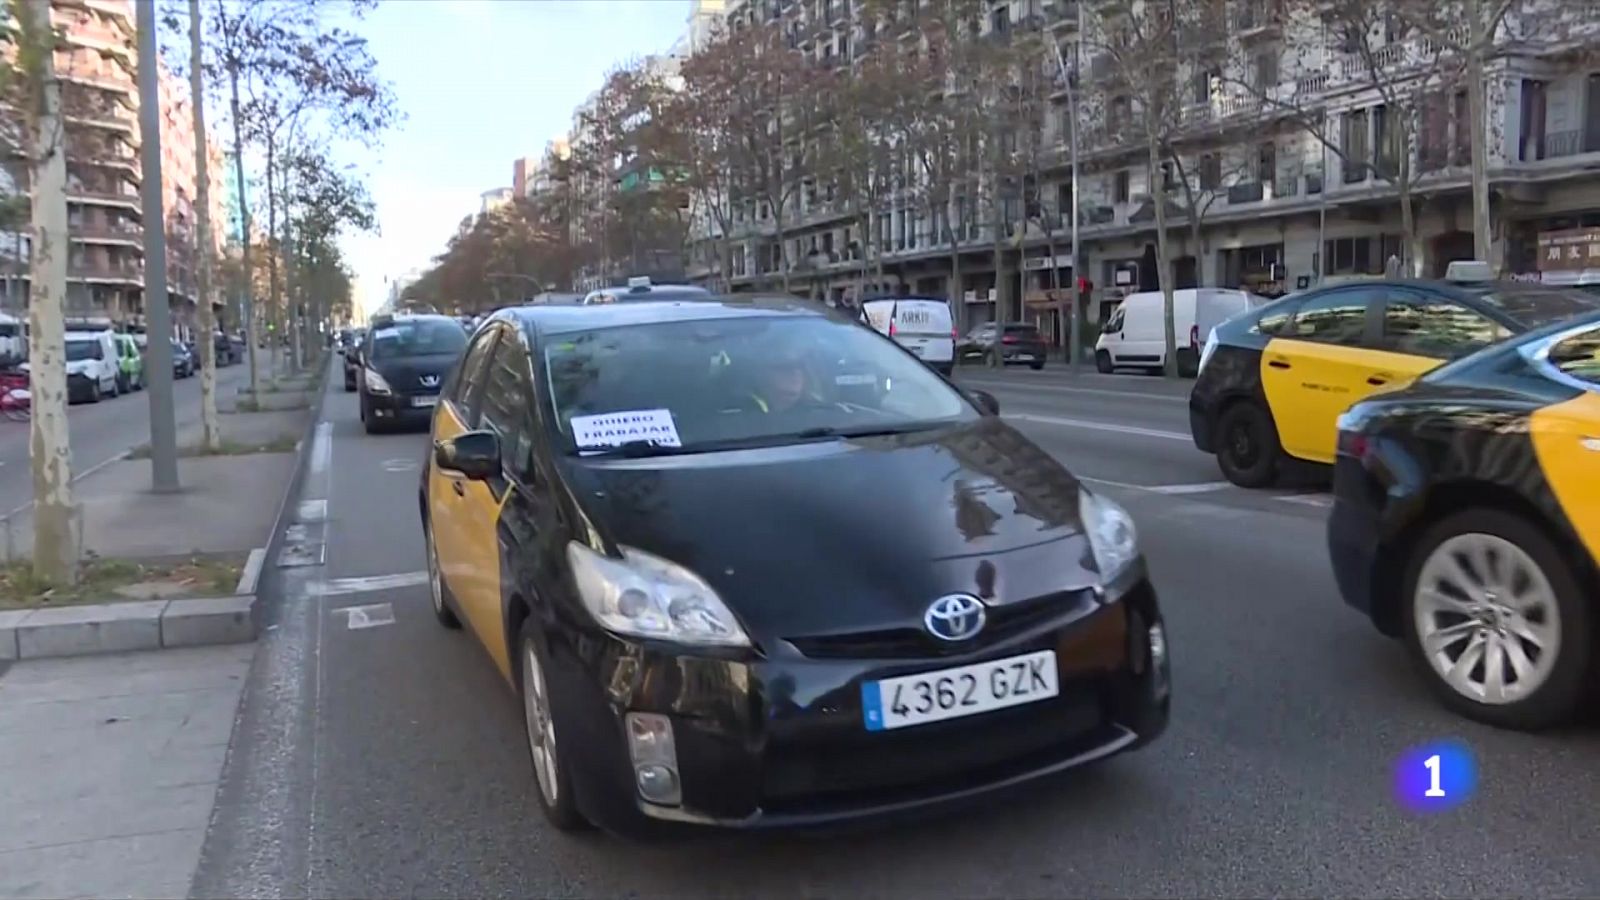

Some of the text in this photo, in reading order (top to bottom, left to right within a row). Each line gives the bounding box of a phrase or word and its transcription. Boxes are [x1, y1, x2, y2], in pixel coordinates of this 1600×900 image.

[593, 416, 654, 426] QUIERO
[584, 425, 670, 439] TRABAJAR
[891, 656, 1049, 719] 4362 GZK
